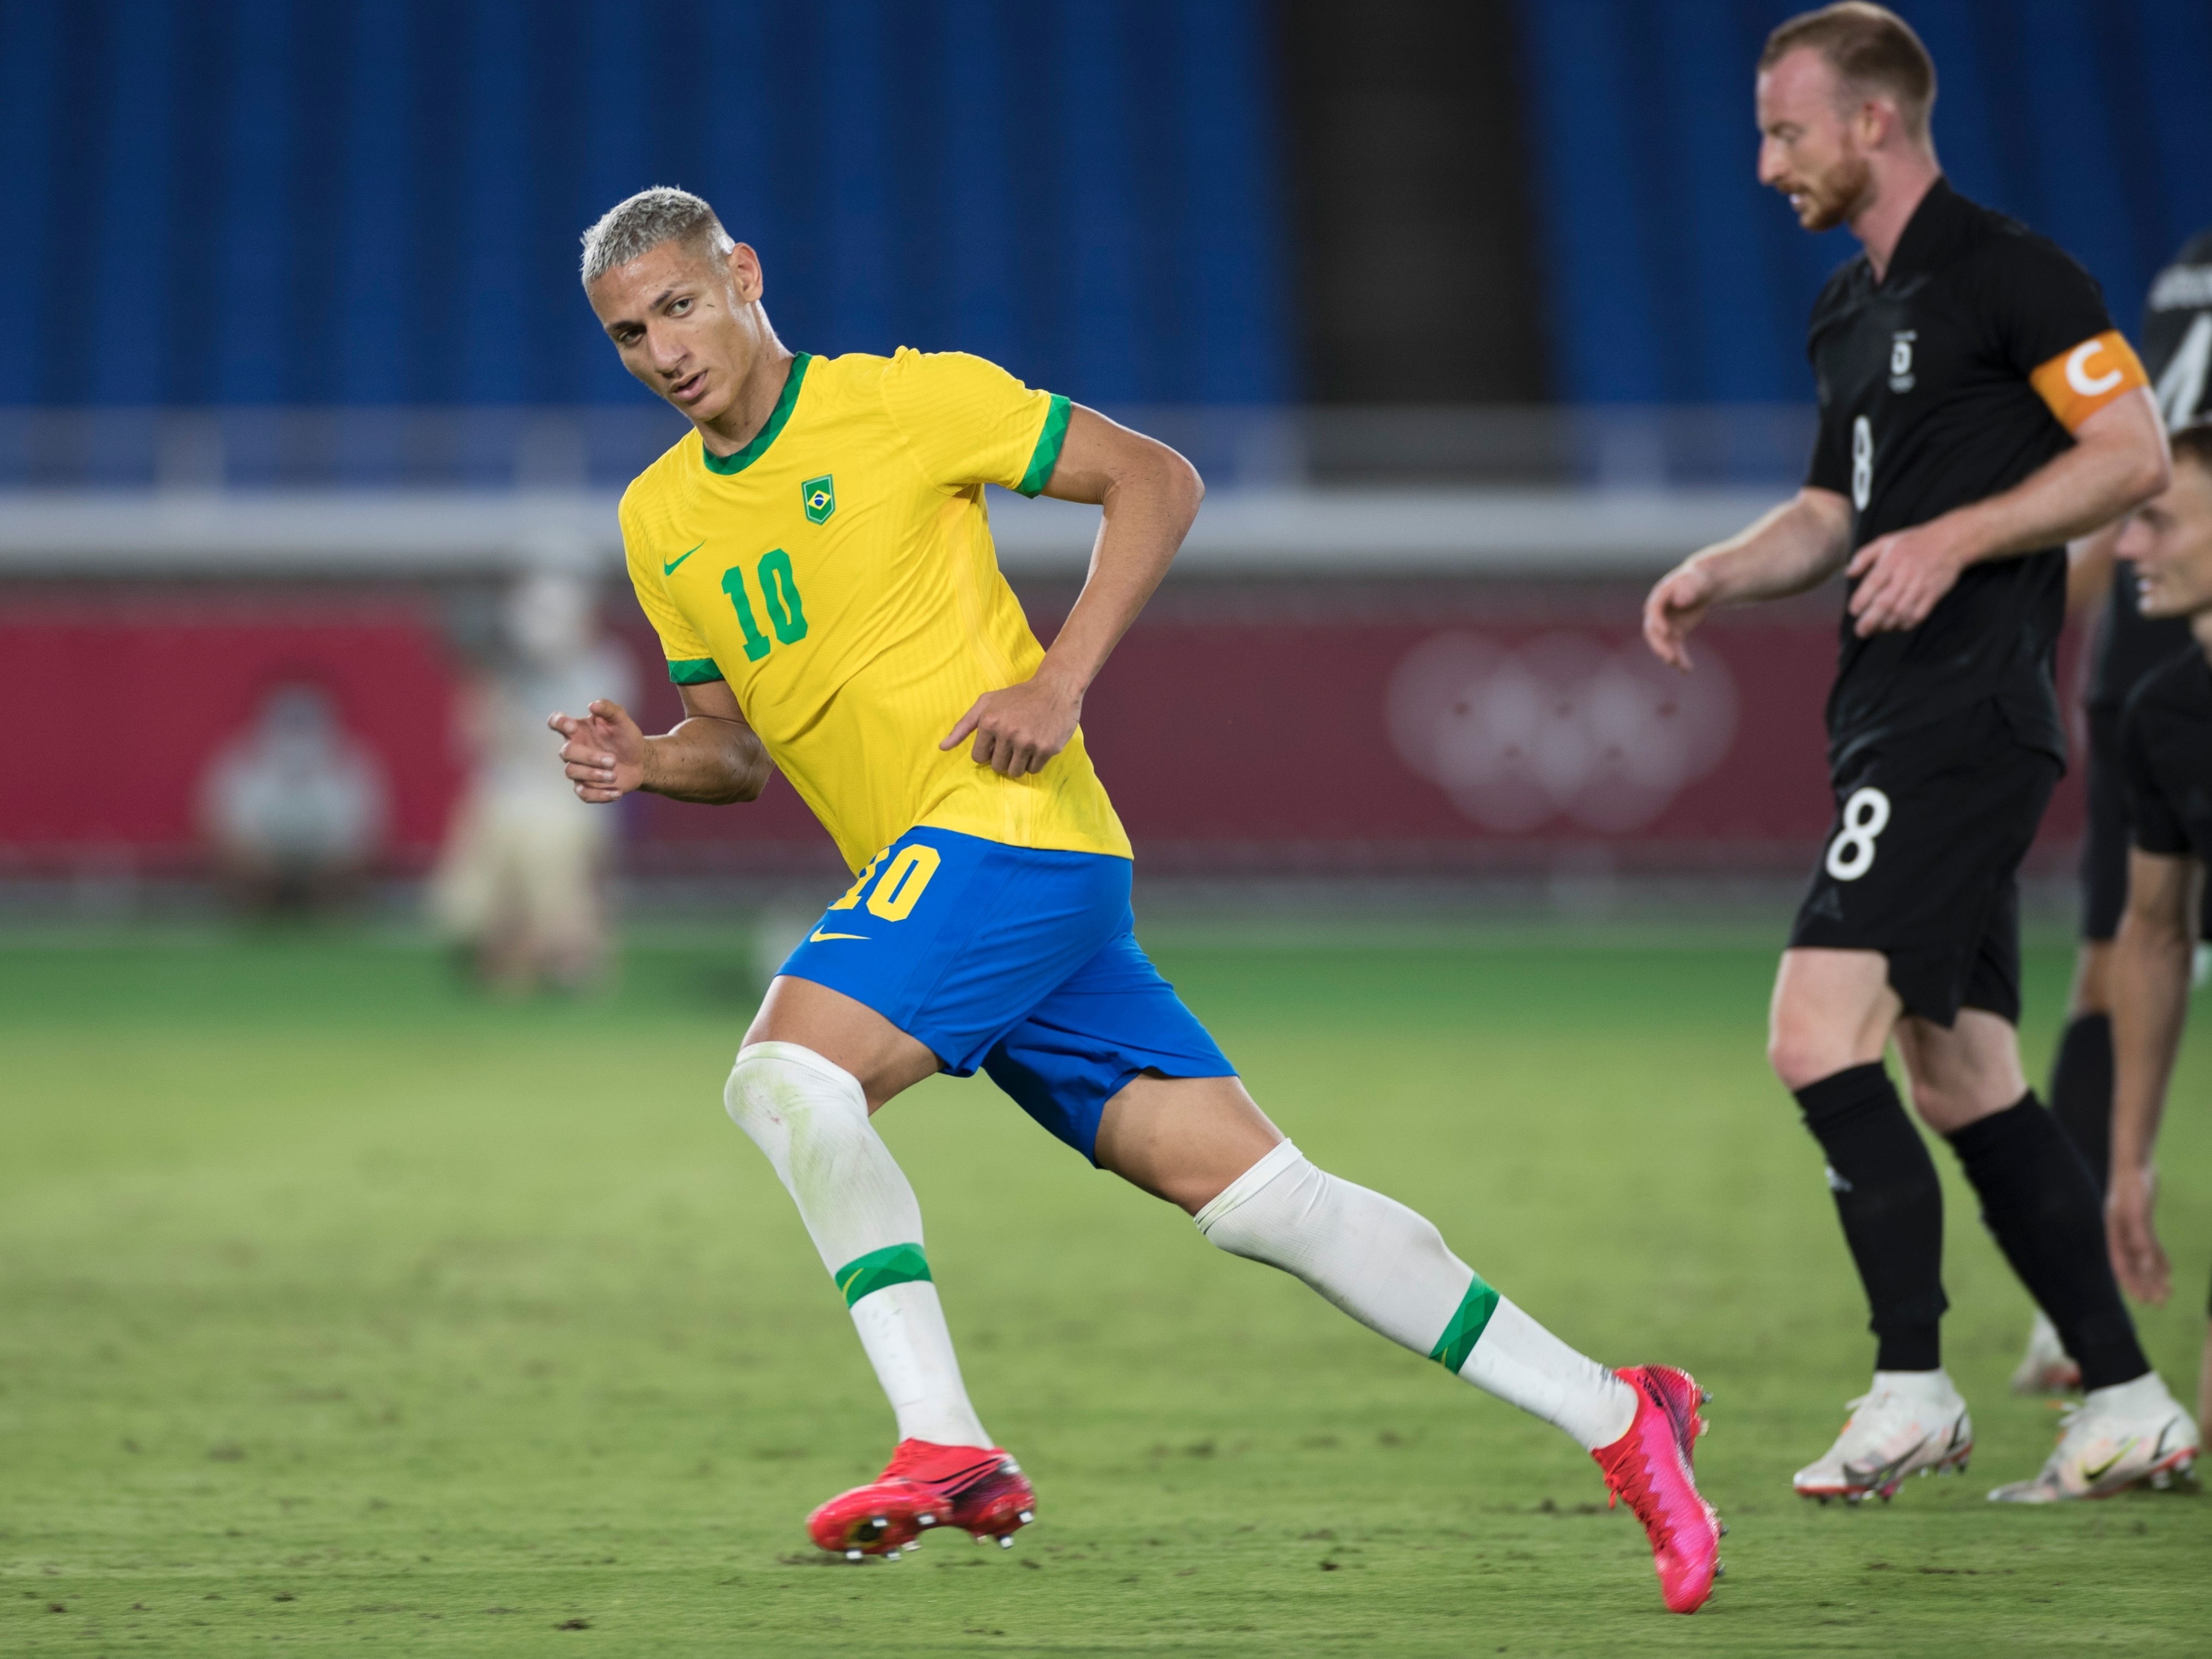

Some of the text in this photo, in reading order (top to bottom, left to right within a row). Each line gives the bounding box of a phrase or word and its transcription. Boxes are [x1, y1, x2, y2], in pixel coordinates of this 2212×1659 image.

[2065, 339, 2123, 396] C
[1852, 413, 1873, 512] 8
[721, 548, 808, 662] 10
[1825, 785, 1891, 882] 8
[827, 843, 941, 922] 10
